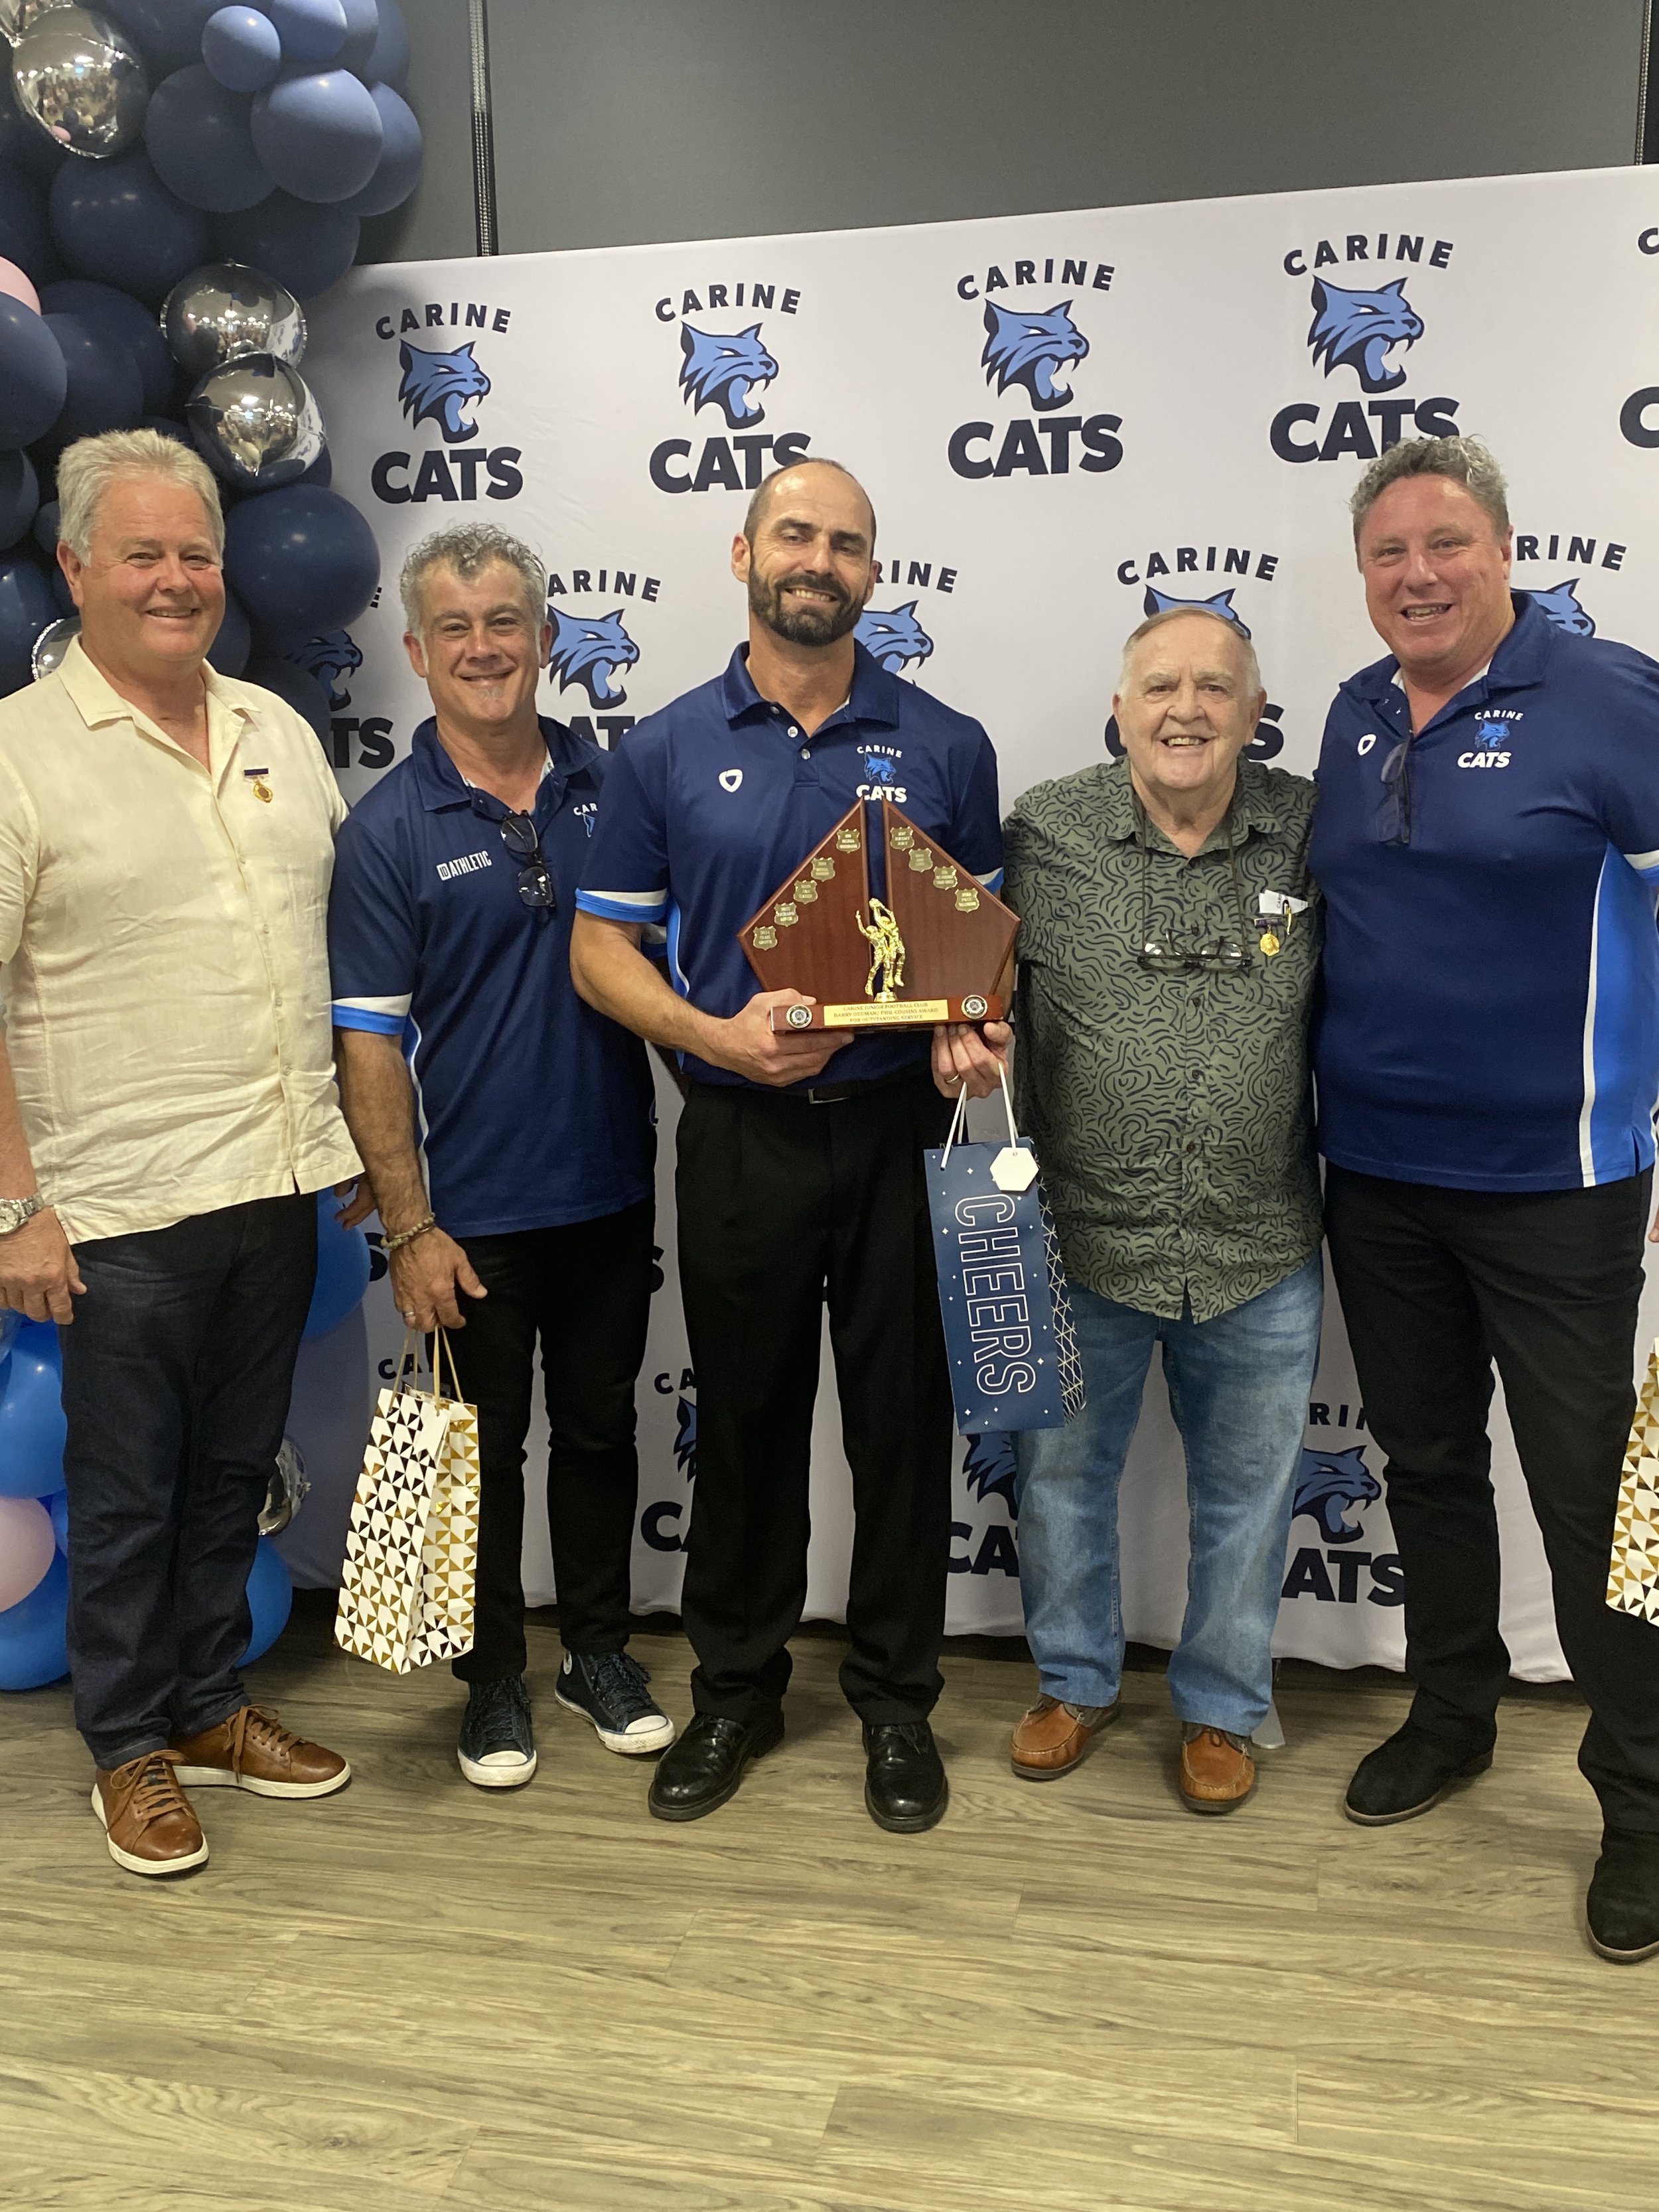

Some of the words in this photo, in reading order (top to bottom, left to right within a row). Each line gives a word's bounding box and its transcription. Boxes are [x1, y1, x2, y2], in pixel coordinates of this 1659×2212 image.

[1283, 234, 1453, 276] CARINE
[957, 258, 1115, 300] CARINE
[376, 302, 511, 339] CARINE
[655, 283, 800, 322] CARINE
[948, 414, 1123, 479] CATS
[1270, 397, 1459, 463] CATS
[371, 447, 523, 504] CATS
[1117, 547, 1279, 585] CARINE
[1517, 535, 1626, 571] RINE
[547, 569, 660, 603] ARINE
[1475, 709, 1524, 720] CARINE
[331, 717, 395, 769] TS
[857, 745, 902, 758] CARINE
[1457, 751, 1512, 768] CATS
[573, 802, 598, 816] CAR
[856, 784, 907, 802] CATS
[449, 850, 492, 877] ATHLETIC
[955, 1194, 1036, 1394] CHEERS
[1281, 1547, 1405, 1607] ATS
